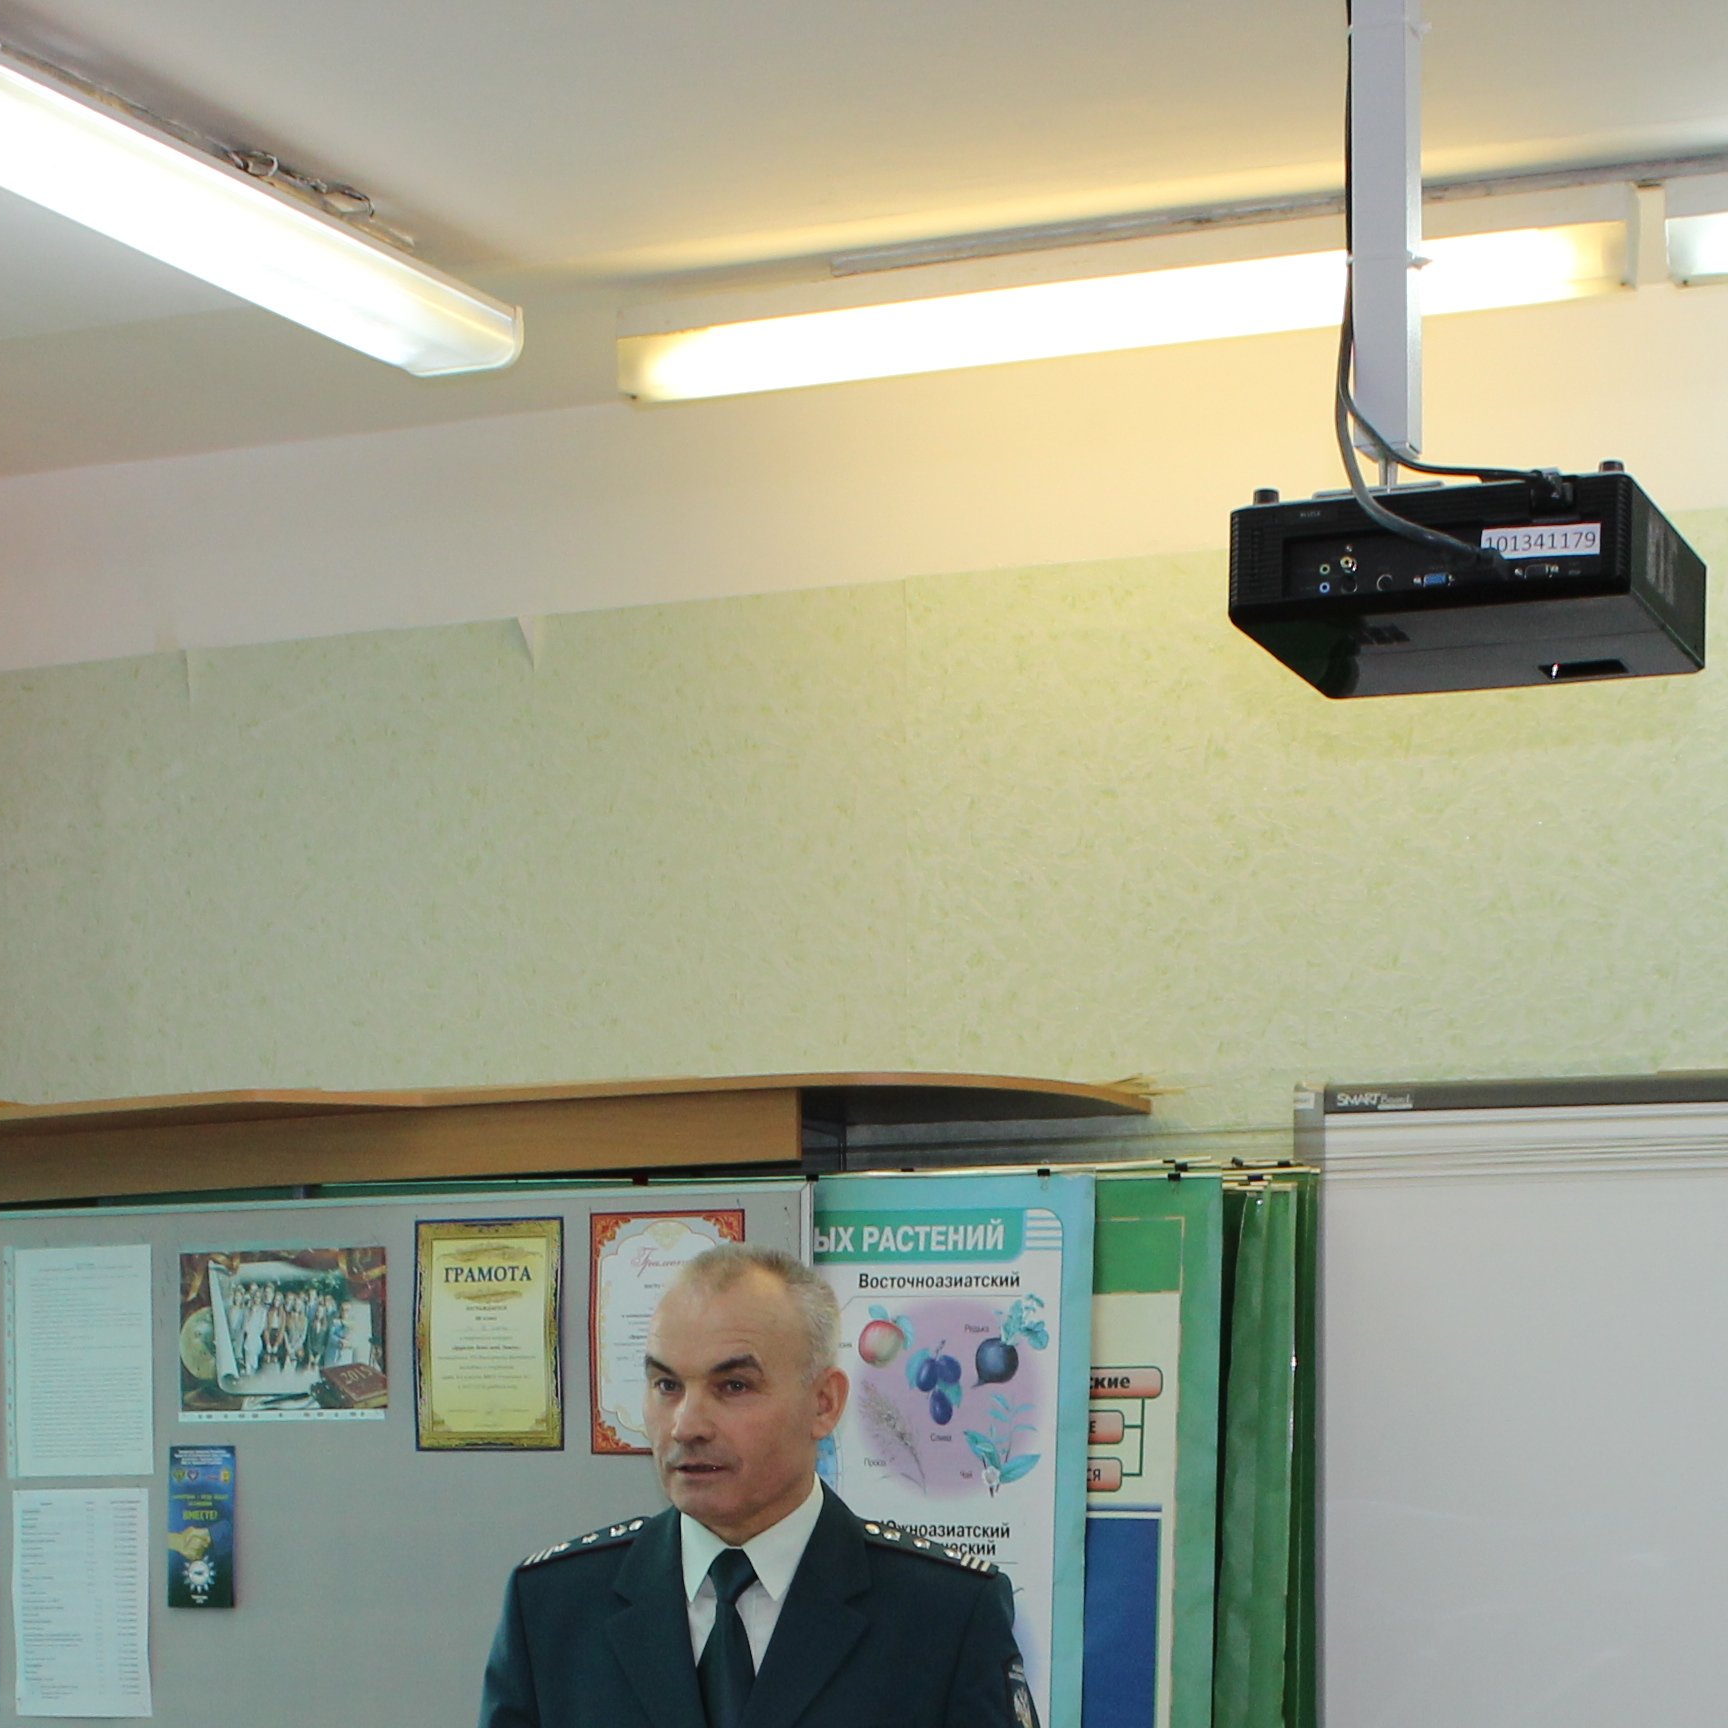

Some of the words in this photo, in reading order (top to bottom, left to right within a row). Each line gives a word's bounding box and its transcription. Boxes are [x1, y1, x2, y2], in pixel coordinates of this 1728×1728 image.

[1484, 531, 1597, 553] 101341179
[1336, 1092, 1381, 1107] SMART
[813, 1226, 855, 1253] ЫХ
[862, 1217, 1005, 1253] РАСТЕНИЙ
[443, 1265, 532, 1283] ГРАМОТА
[858, 1271, 1021, 1290] Восточноазиатский
[1090, 1376, 1131, 1389] кие
[942, 1540, 996, 1556] еский
